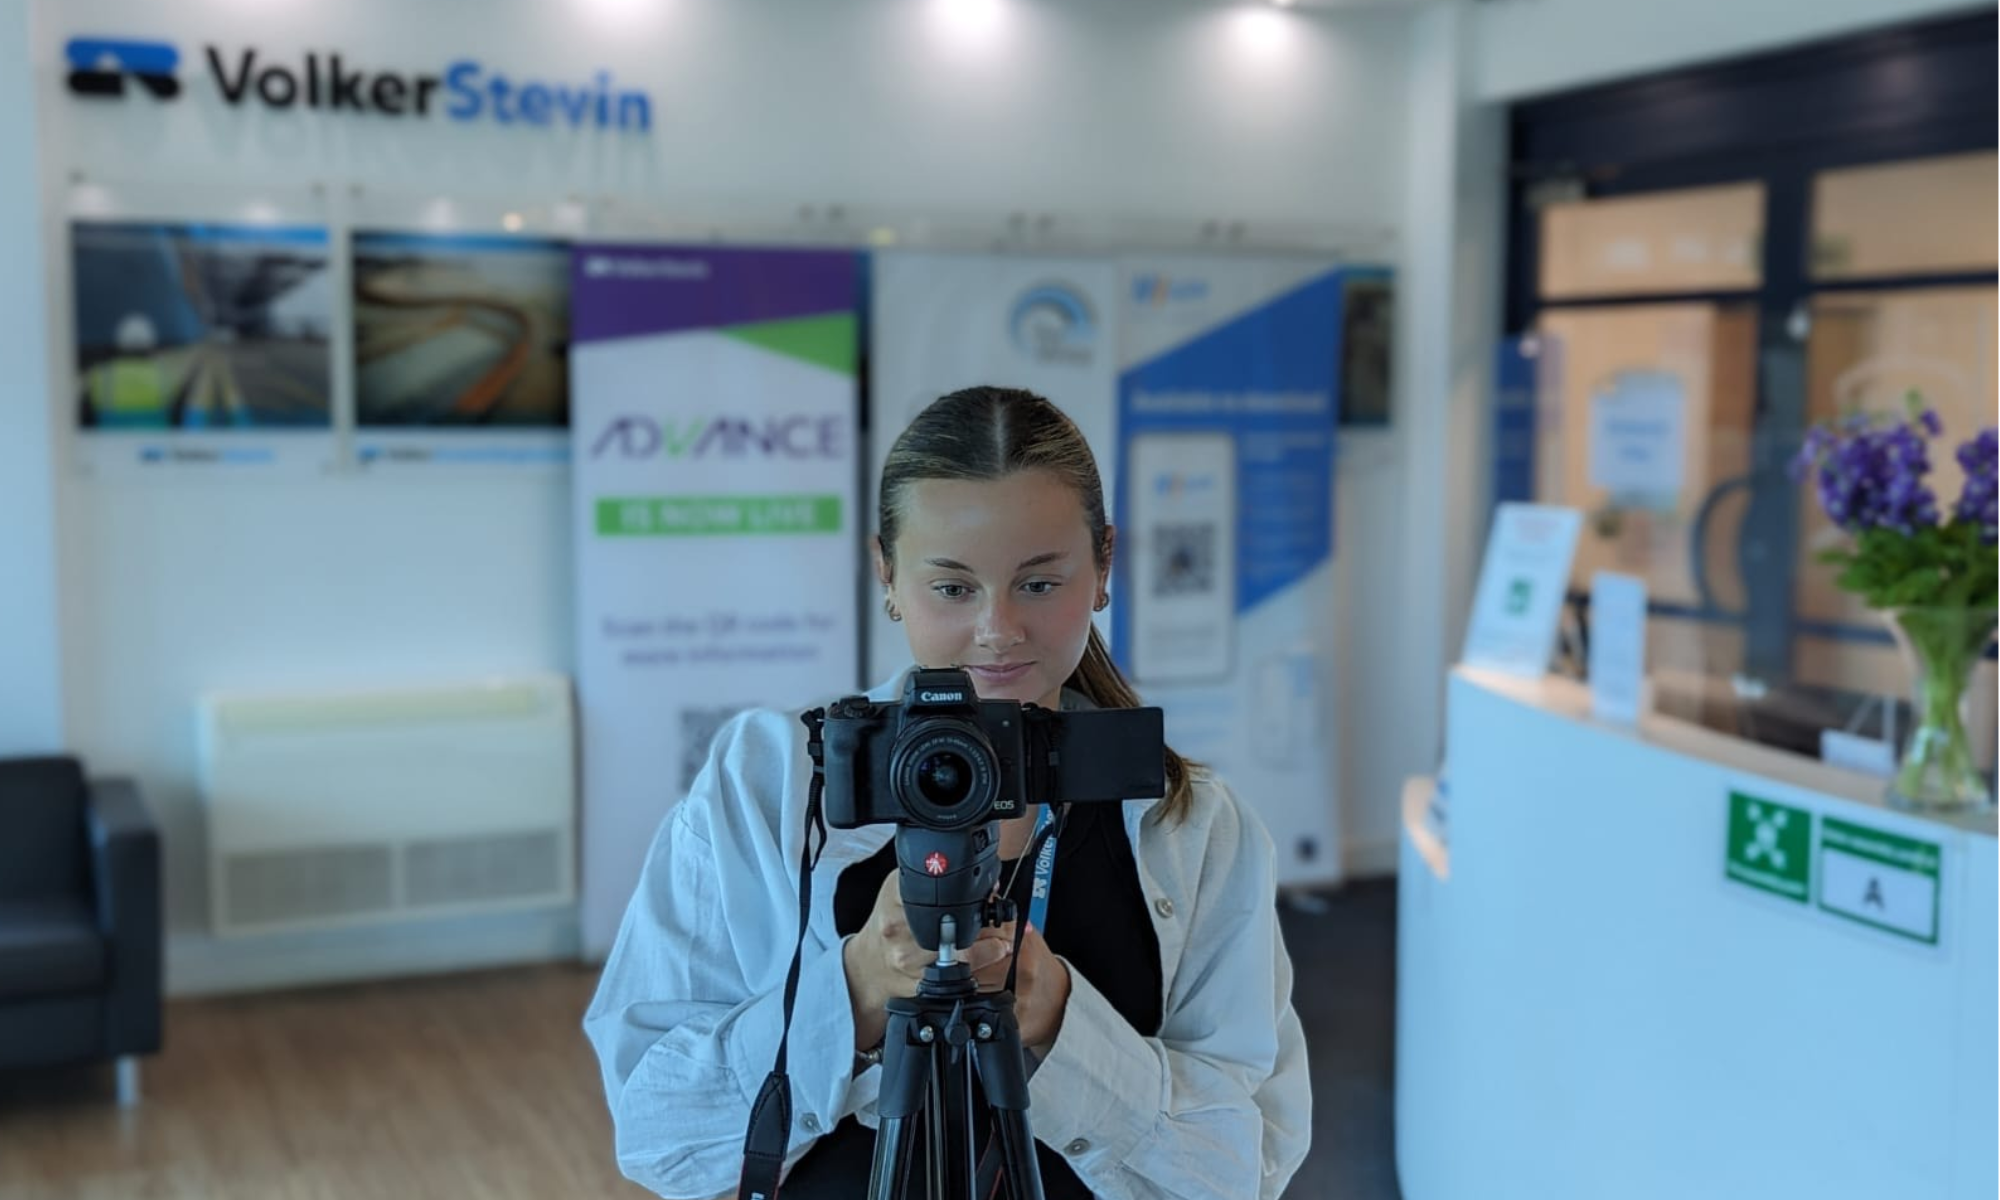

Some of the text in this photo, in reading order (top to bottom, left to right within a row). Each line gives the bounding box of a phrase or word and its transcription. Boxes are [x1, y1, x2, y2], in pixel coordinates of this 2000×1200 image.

[205, 46, 652, 131] VolkerStevin
[590, 413, 845, 460] ADVANCE
[921, 691, 962, 702] Canon
[994, 800, 1014, 809] EOS
[1863, 876, 1884, 909] A
